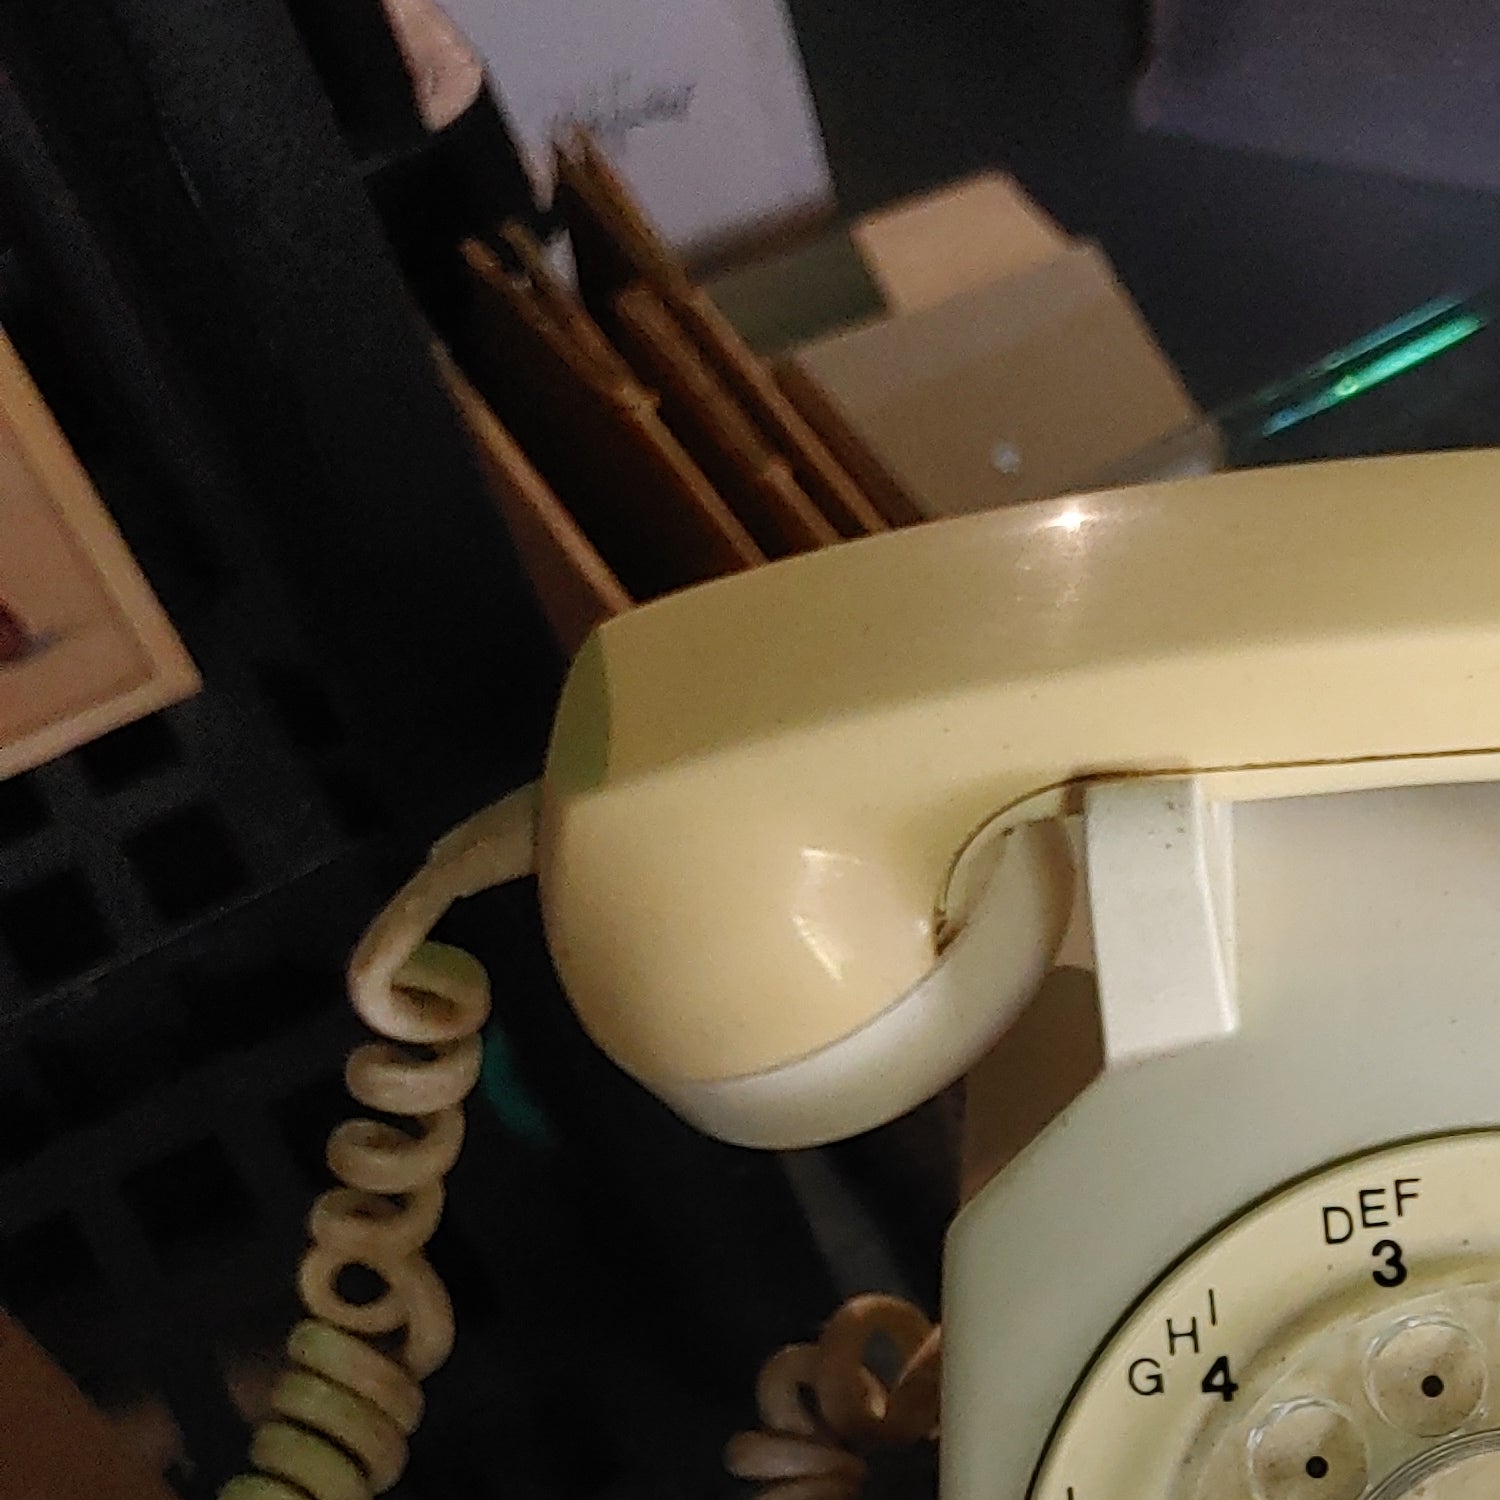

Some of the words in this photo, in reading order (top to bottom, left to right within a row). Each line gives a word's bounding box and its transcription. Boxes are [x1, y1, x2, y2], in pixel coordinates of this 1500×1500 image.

[1322, 1178, 1421, 1245] DEF
[1372, 1240, 1409, 1288] 3
[1128, 1289, 1218, 1396] GHI
[1201, 1356, 1240, 1402] 4
